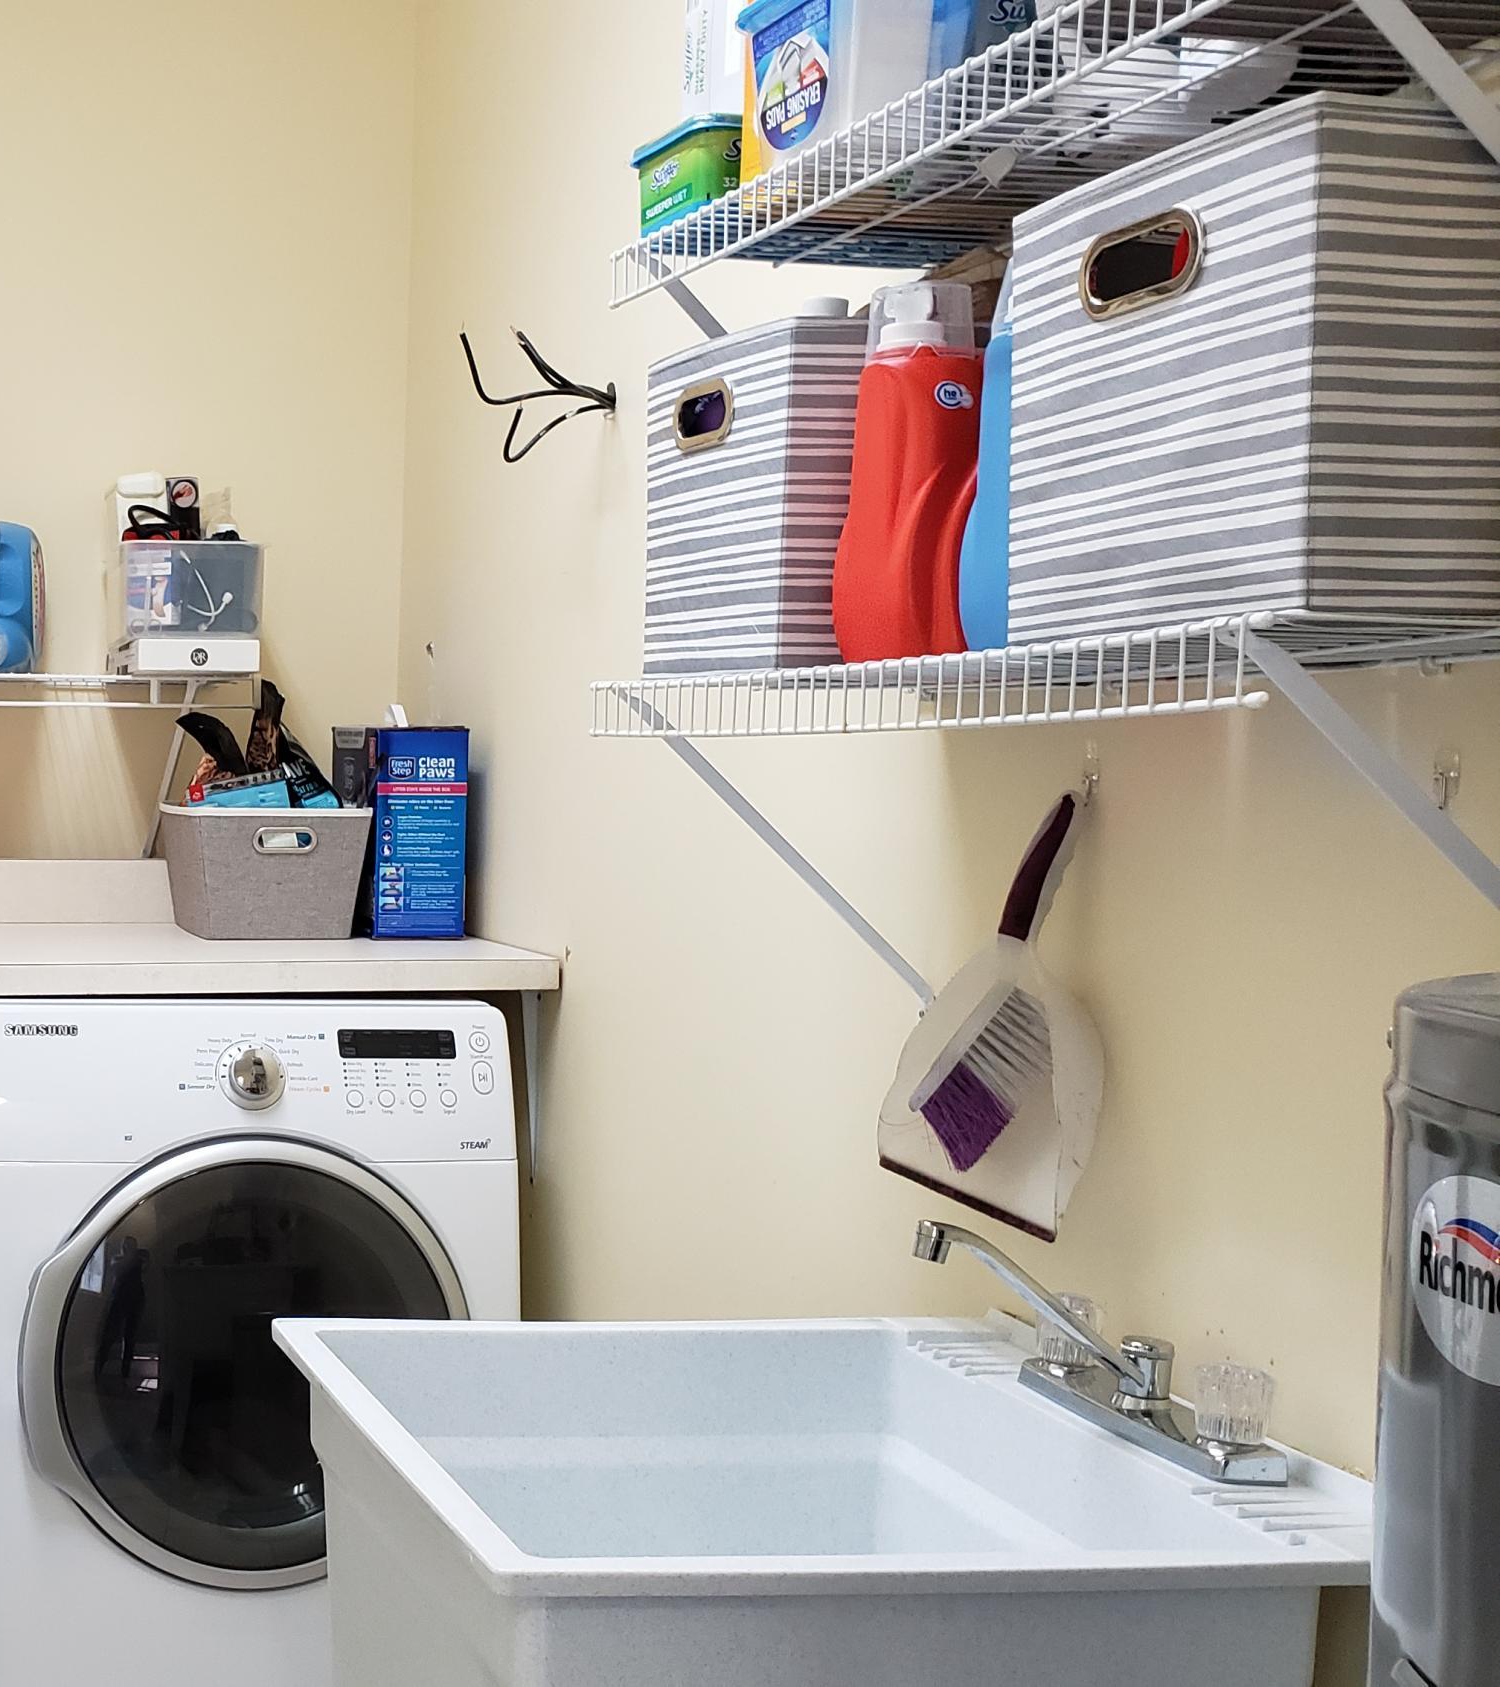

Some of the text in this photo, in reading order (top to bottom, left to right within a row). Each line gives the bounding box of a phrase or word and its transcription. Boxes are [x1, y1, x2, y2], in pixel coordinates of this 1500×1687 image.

[765, 81, 820, 130] ERASING PADS
[391, 760, 413, 769] Fresh
[418, 757, 455, 768] Clean
[392, 767, 412, 776] Step
[4, 1024, 78, 1036] SAMSUNG
[460, 1141, 488, 1149] STEAM
[1419, 1230, 1500, 1314] Richm
